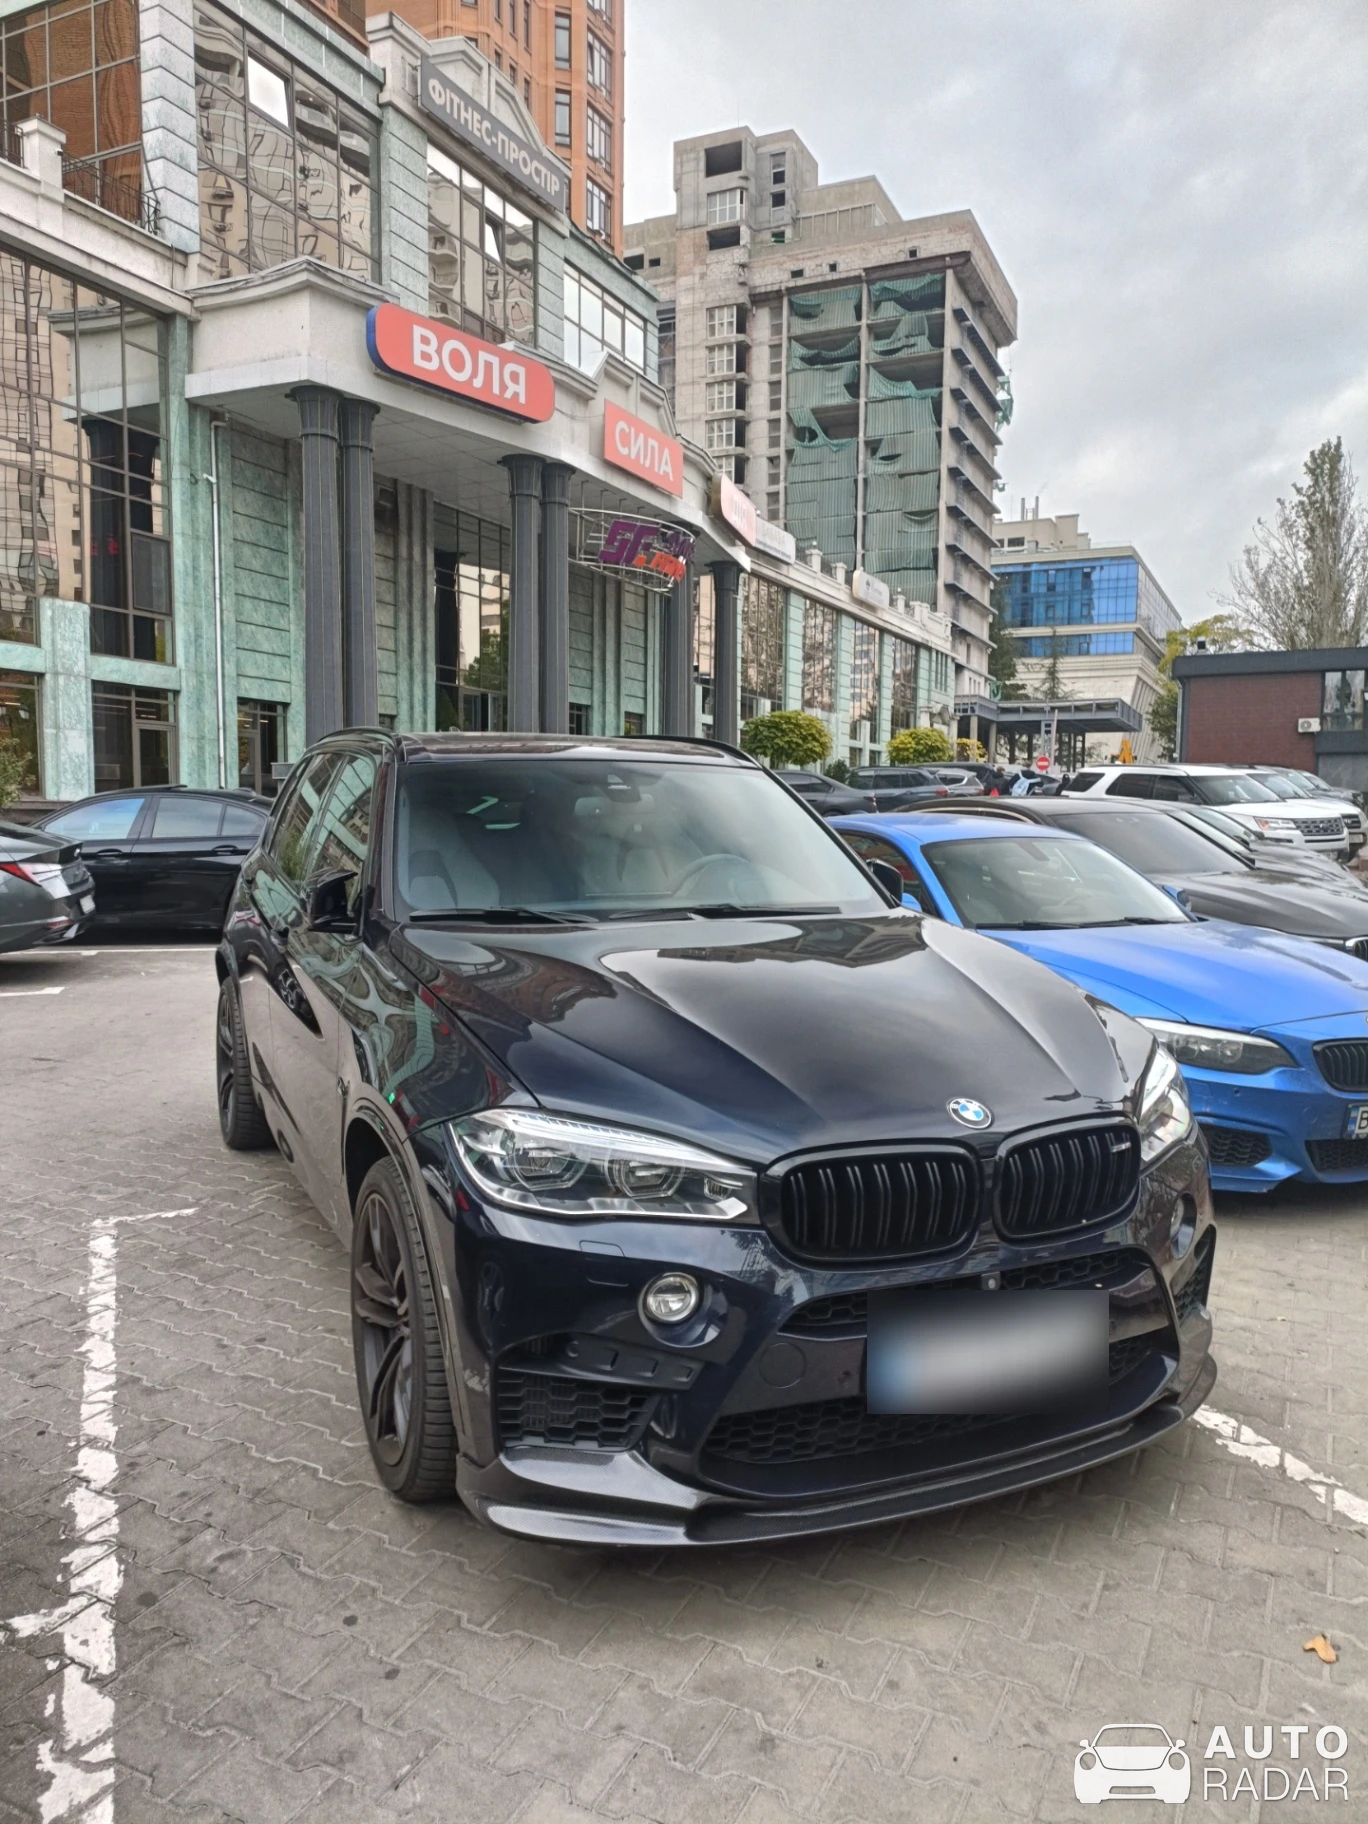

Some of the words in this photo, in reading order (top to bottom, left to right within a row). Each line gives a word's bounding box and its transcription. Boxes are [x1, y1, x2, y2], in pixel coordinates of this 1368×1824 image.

[428, 78, 560, 197] ФІТНЕС-ПРОСТІР
[412, 324, 526, 405] ВОЛЯ
[615, 420, 674, 482] СИЛА
